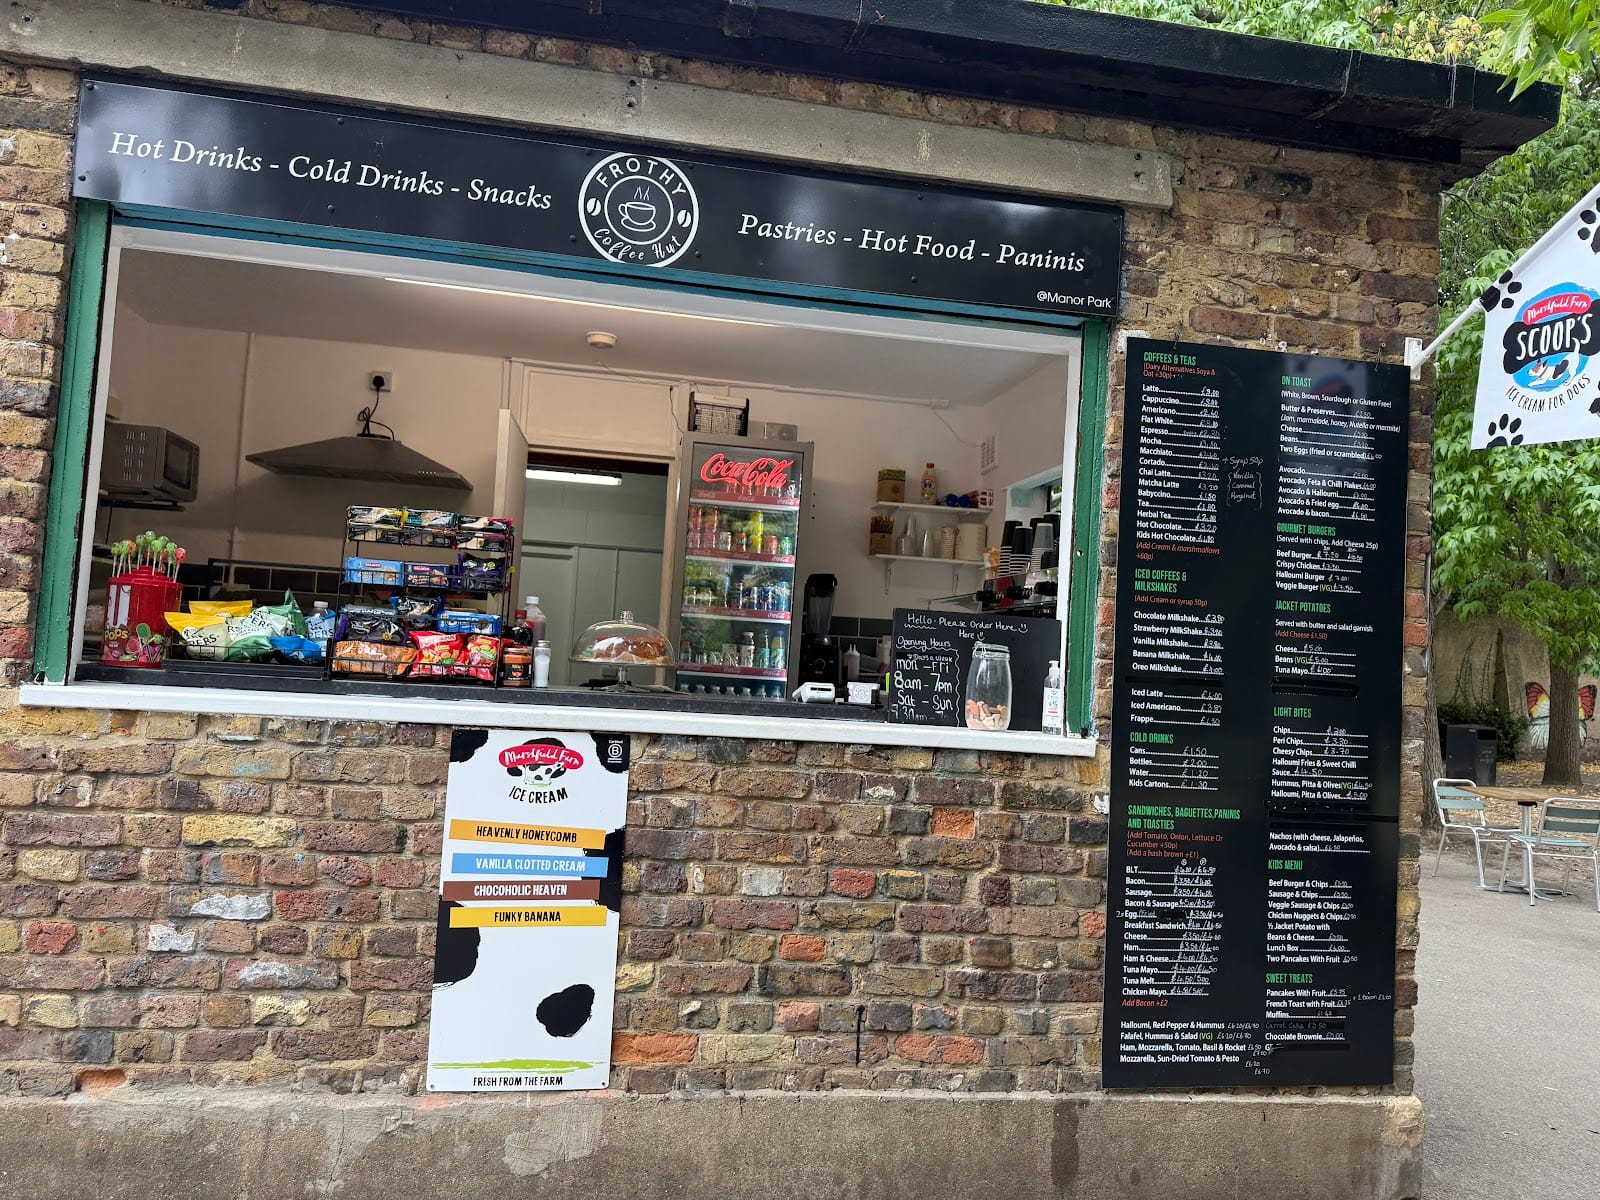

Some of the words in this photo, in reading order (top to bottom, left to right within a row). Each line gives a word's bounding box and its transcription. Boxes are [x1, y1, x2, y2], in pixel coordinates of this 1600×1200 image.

[108, 131, 165, 161] Hot
[170, 140, 262, 174] Drinks
[289, 155, 352, 184] Cold
[357, 164, 444, 196] Drinks
[468, 178, 553, 210] Snacks
[596, 158, 686, 195] FROTHY
[594, 228, 645, 260] Coffee
[652, 235, 681, 259] Hut
[737, 213, 837, 245] Pastries
[859, 228, 909, 254] Hot
[913, 235, 974, 261] Food
[996, 244, 1086, 274] Paninis
[1037, 291, 1085, 307] @Manor
[1088, 295, 1112, 309] Park
[1527, 297, 1569, 322] Marshfield
[1570, 298, 1588, 309] Farm
[1516, 313, 1593, 361] SCOOP'S
[1144, 352, 1172, 363] COFFEES
[1180, 355, 1196, 366] TEAS
[1282, 376, 1290, 385] ON
[1292, 377, 1312, 387] TOAST
[1506, 385, 1518, 401] ICE
[1518, 395, 1546, 412] CREAM
[1549, 393, 1565, 411] FOR
[1567, 374, 1591, 398] DOGS
[1321, 395, 1352, 404] Sourdough
[1359, 397, 1377, 406] Gluten
[1141, 416, 1153, 424] Flat
[701, 453, 794, 488] Coca-Cola
[1139, 479, 1162, 488] Matcha
[1163, 480, 1180, 489] Latte
[1277, 522, 1306, 534] GOURMET
[1308, 525, 1336, 536] BURGERS
[1135, 568, 1150, 579] ICED
[1152, 570, 1181, 581] COFFEES
[1276, 571, 1304, 579] Halloumi
[1305, 573, 1325, 582] Burger
[1135, 581, 1177, 593] MILKSHAKES
[1150, 596, 1168, 604] Cream
[1177, 598, 1193, 607] syrup
[1275, 600, 1298, 611] JACKET
[1300, 601, 1332, 613] POTATOES
[939, 617, 966, 628] Please
[970, 620, 993, 630] Order
[1275, 619, 1294, 627] Served
[1309, 621, 1326, 629] butter
[1338, 623, 1352, 631] salad
[1353, 624, 1373, 633] garnish
[959, 630, 975, 639] Here
[898, 636, 927, 651] Opening
[930, 638, 951, 648] Hours
[894, 671, 922, 690] 8am
[930, 673, 952, 693] 7pm
[1132, 689, 1145, 697] Iced
[1146, 689, 1164, 697] Latte
[898, 690, 916, 706] Sat
[933, 695, 953, 710] Sun
[1273, 707, 1292, 717] LIGHT
[1294, 708, 1312, 718] BITES
[1130, 732, 1147, 743] COLD
[1149, 733, 1174, 744] DRINKS
[504, 746, 558, 766] Marshfield
[559, 751, 580, 766] Farm
[1273, 748, 1295, 756] Cheesy
[1272, 758, 1300, 766] Halloumi
[1322, 760, 1340, 768] Sweet
[1341, 761, 1357, 769] Chilli
[509, 786, 525, 802] ICE
[528, 787, 568, 804] CREAM
[1128, 818, 1141, 829] AND
[1144, 819, 1175, 830] TOASTIES
[476, 826, 521, 840] HEAVENLY
[522, 829, 577, 843] HONEYCOMB
[1270, 832, 1292, 841] Nachos
[1293, 833, 1309, 841] (with
[476, 858, 513, 870] VANILLA
[515, 860, 551, 871] CLOTTED
[553, 861, 586, 872] CREAM
[1268, 859, 1283, 870] KIDS
[1285, 860, 1303, 870] MENU
[1269, 879, 1283, 887] Beef
[1284, 880, 1304, 889] Burger
[1311, 880, 1328, 889] Chips
[474, 885, 531, 896] CHOCOHOLIC
[533, 885, 567, 896] HEAVEN
[494, 912, 523, 923] FUNKY
[525, 911, 561, 922] BANANA
[1281, 955, 1309, 963] Pancakes
[1310, 955, 1324, 963] With
[1266, 973, 1287, 984] SWEET
[1289, 974, 1313, 984] TREATS
[1121, 1022, 1152, 1030] Halloumi,
[1153, 1021, 1165, 1029] Red
[1166, 1022, 1189, 1031] Pepper
[1121, 1032, 1143, 1040] Falafel,
[1181, 1032, 1198, 1040] Salad
[1199, 1033, 1213, 1041] (VG)
[1120, 1043, 1137, 1052] Ham,
[1138, 1044, 1174, 1052] Mozzarella,
[1176, 1044, 1202, 1052] Tomato,
[1120, 1055, 1156, 1064] Mozzarella,
[1157, 1055, 1189, 1063] Sun-Dried
[1191, 1055, 1215, 1063] Tomato
[1222, 1055, 1239, 1063] Pesto
[473, 1077, 497, 1087] FRESH
[499, 1077, 522, 1086] FROM
[525, 1077, 539, 1086] THE
[540, 1076, 563, 1086] FARM
